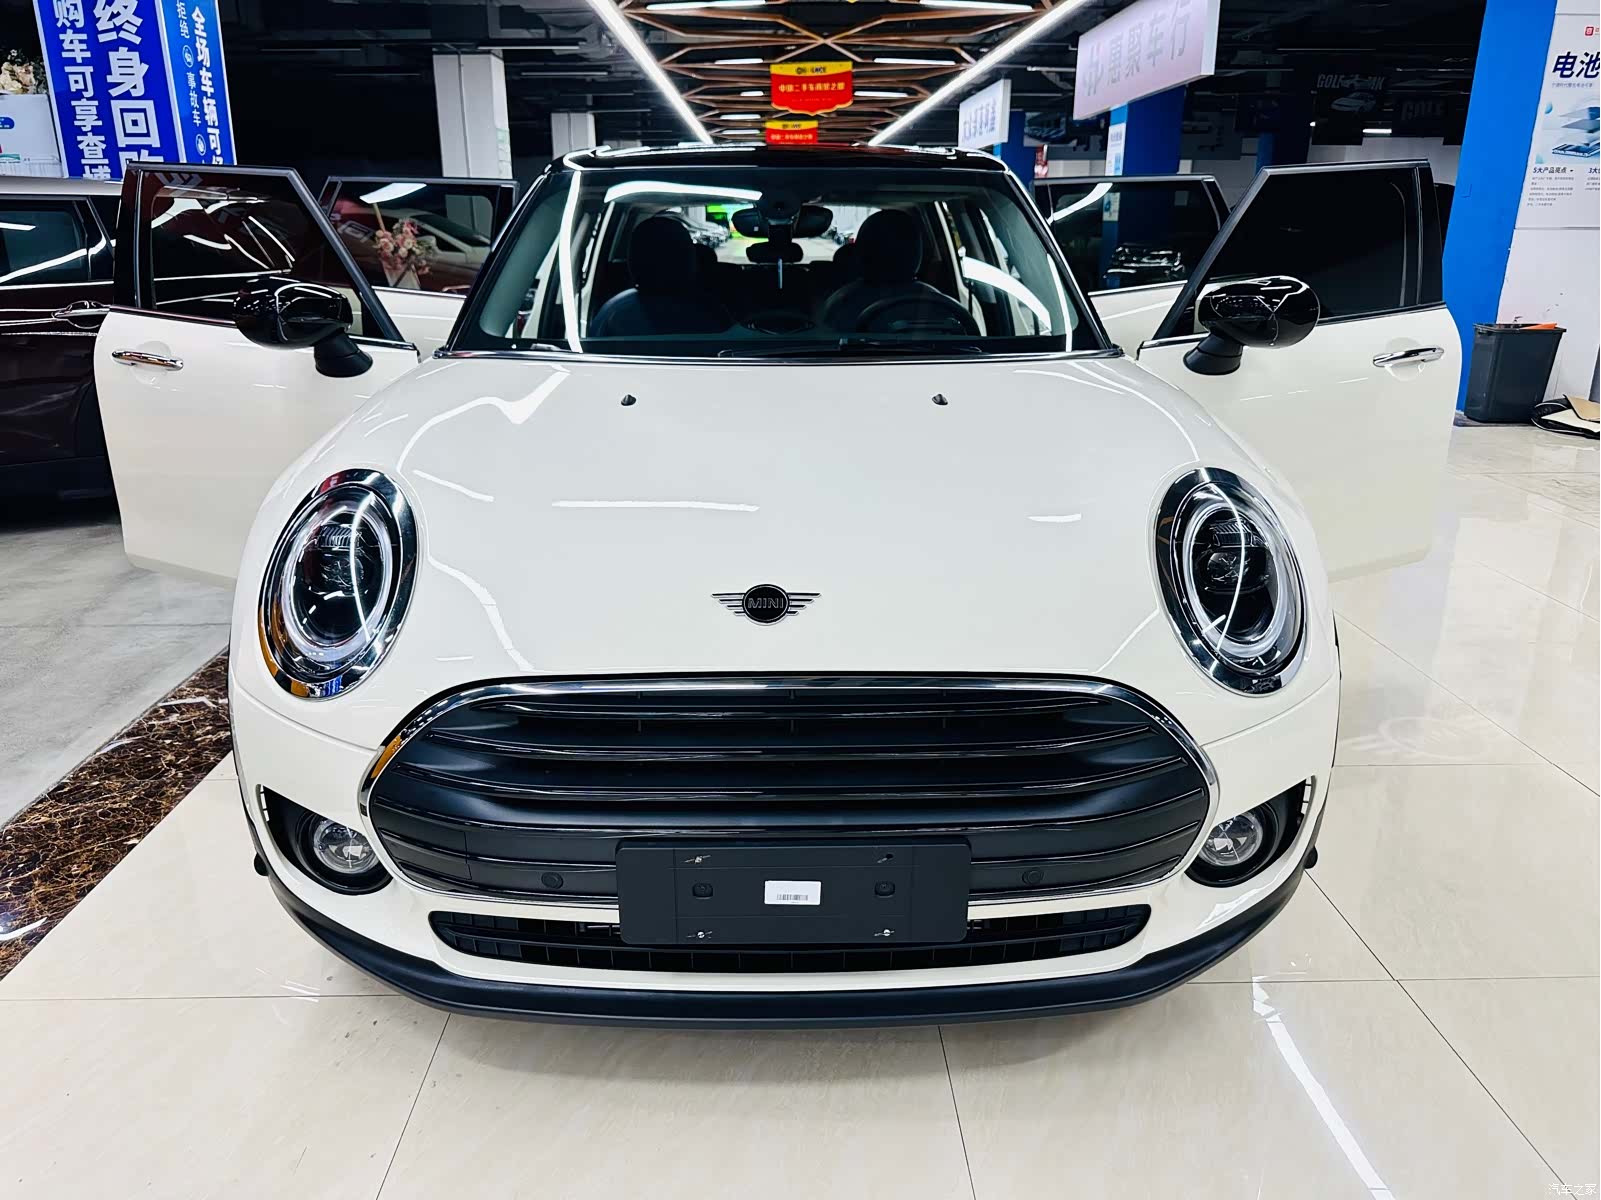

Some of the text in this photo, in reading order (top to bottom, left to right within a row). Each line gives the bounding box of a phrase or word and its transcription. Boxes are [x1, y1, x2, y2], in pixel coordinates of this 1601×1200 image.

[1552, 51, 1600, 78] 电池
[93, 0, 164, 180] 终身回
[186, 71, 202, 127] 事故车
[747, 597, 784, 609] MINI
